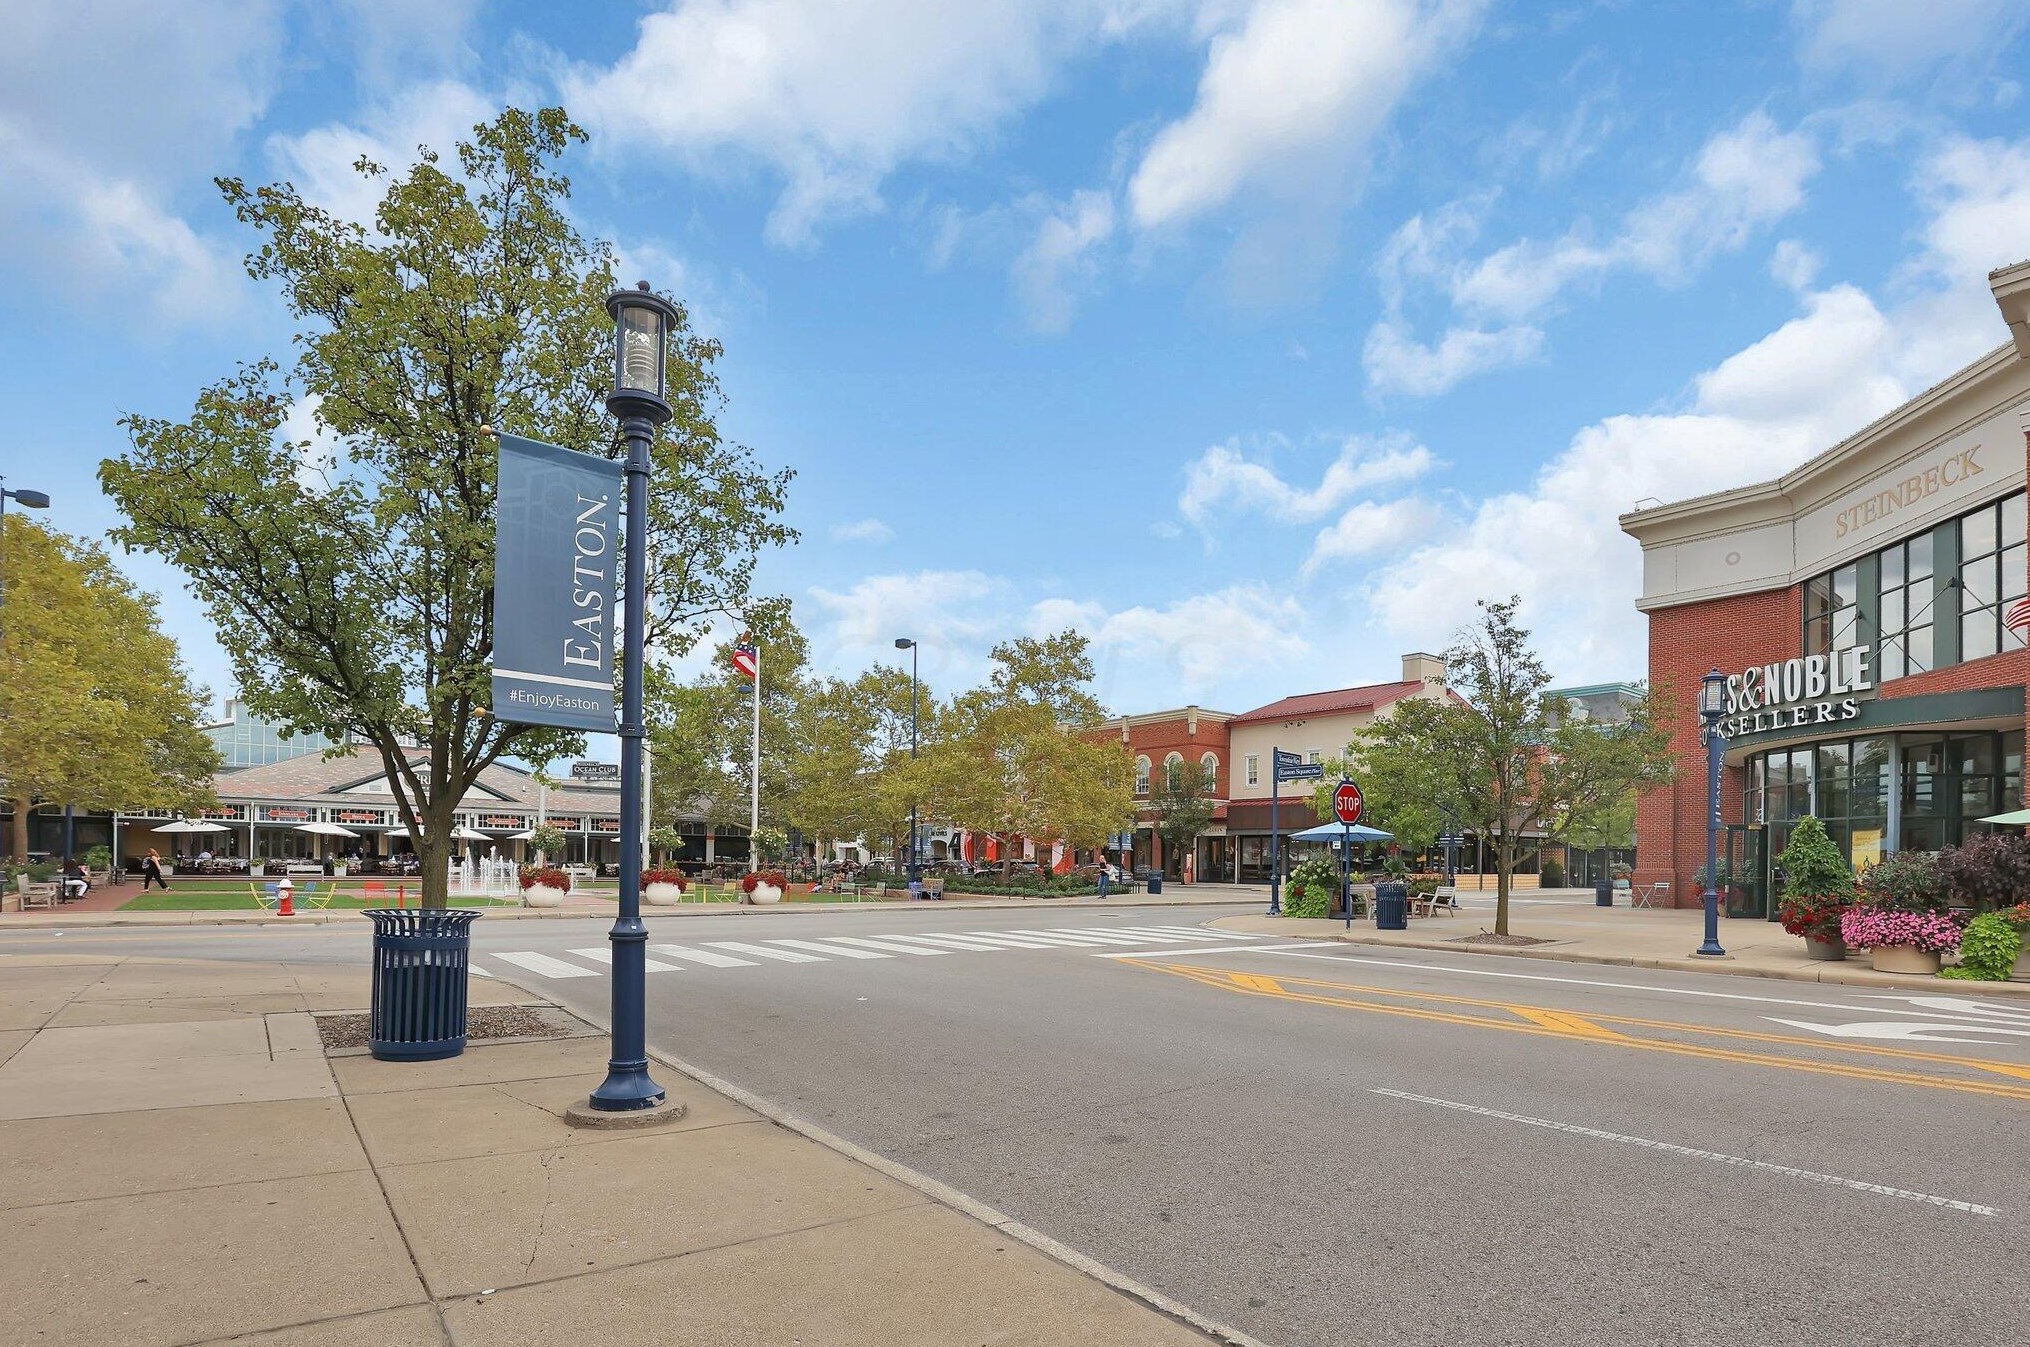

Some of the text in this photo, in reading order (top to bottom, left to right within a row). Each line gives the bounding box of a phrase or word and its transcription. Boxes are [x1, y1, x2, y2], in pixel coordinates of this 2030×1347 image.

[1836, 444, 1984, 540] STEINBECK
[509, 689, 599, 711] #EnjoyEaston
[1337, 796, 1360, 811] STOP
